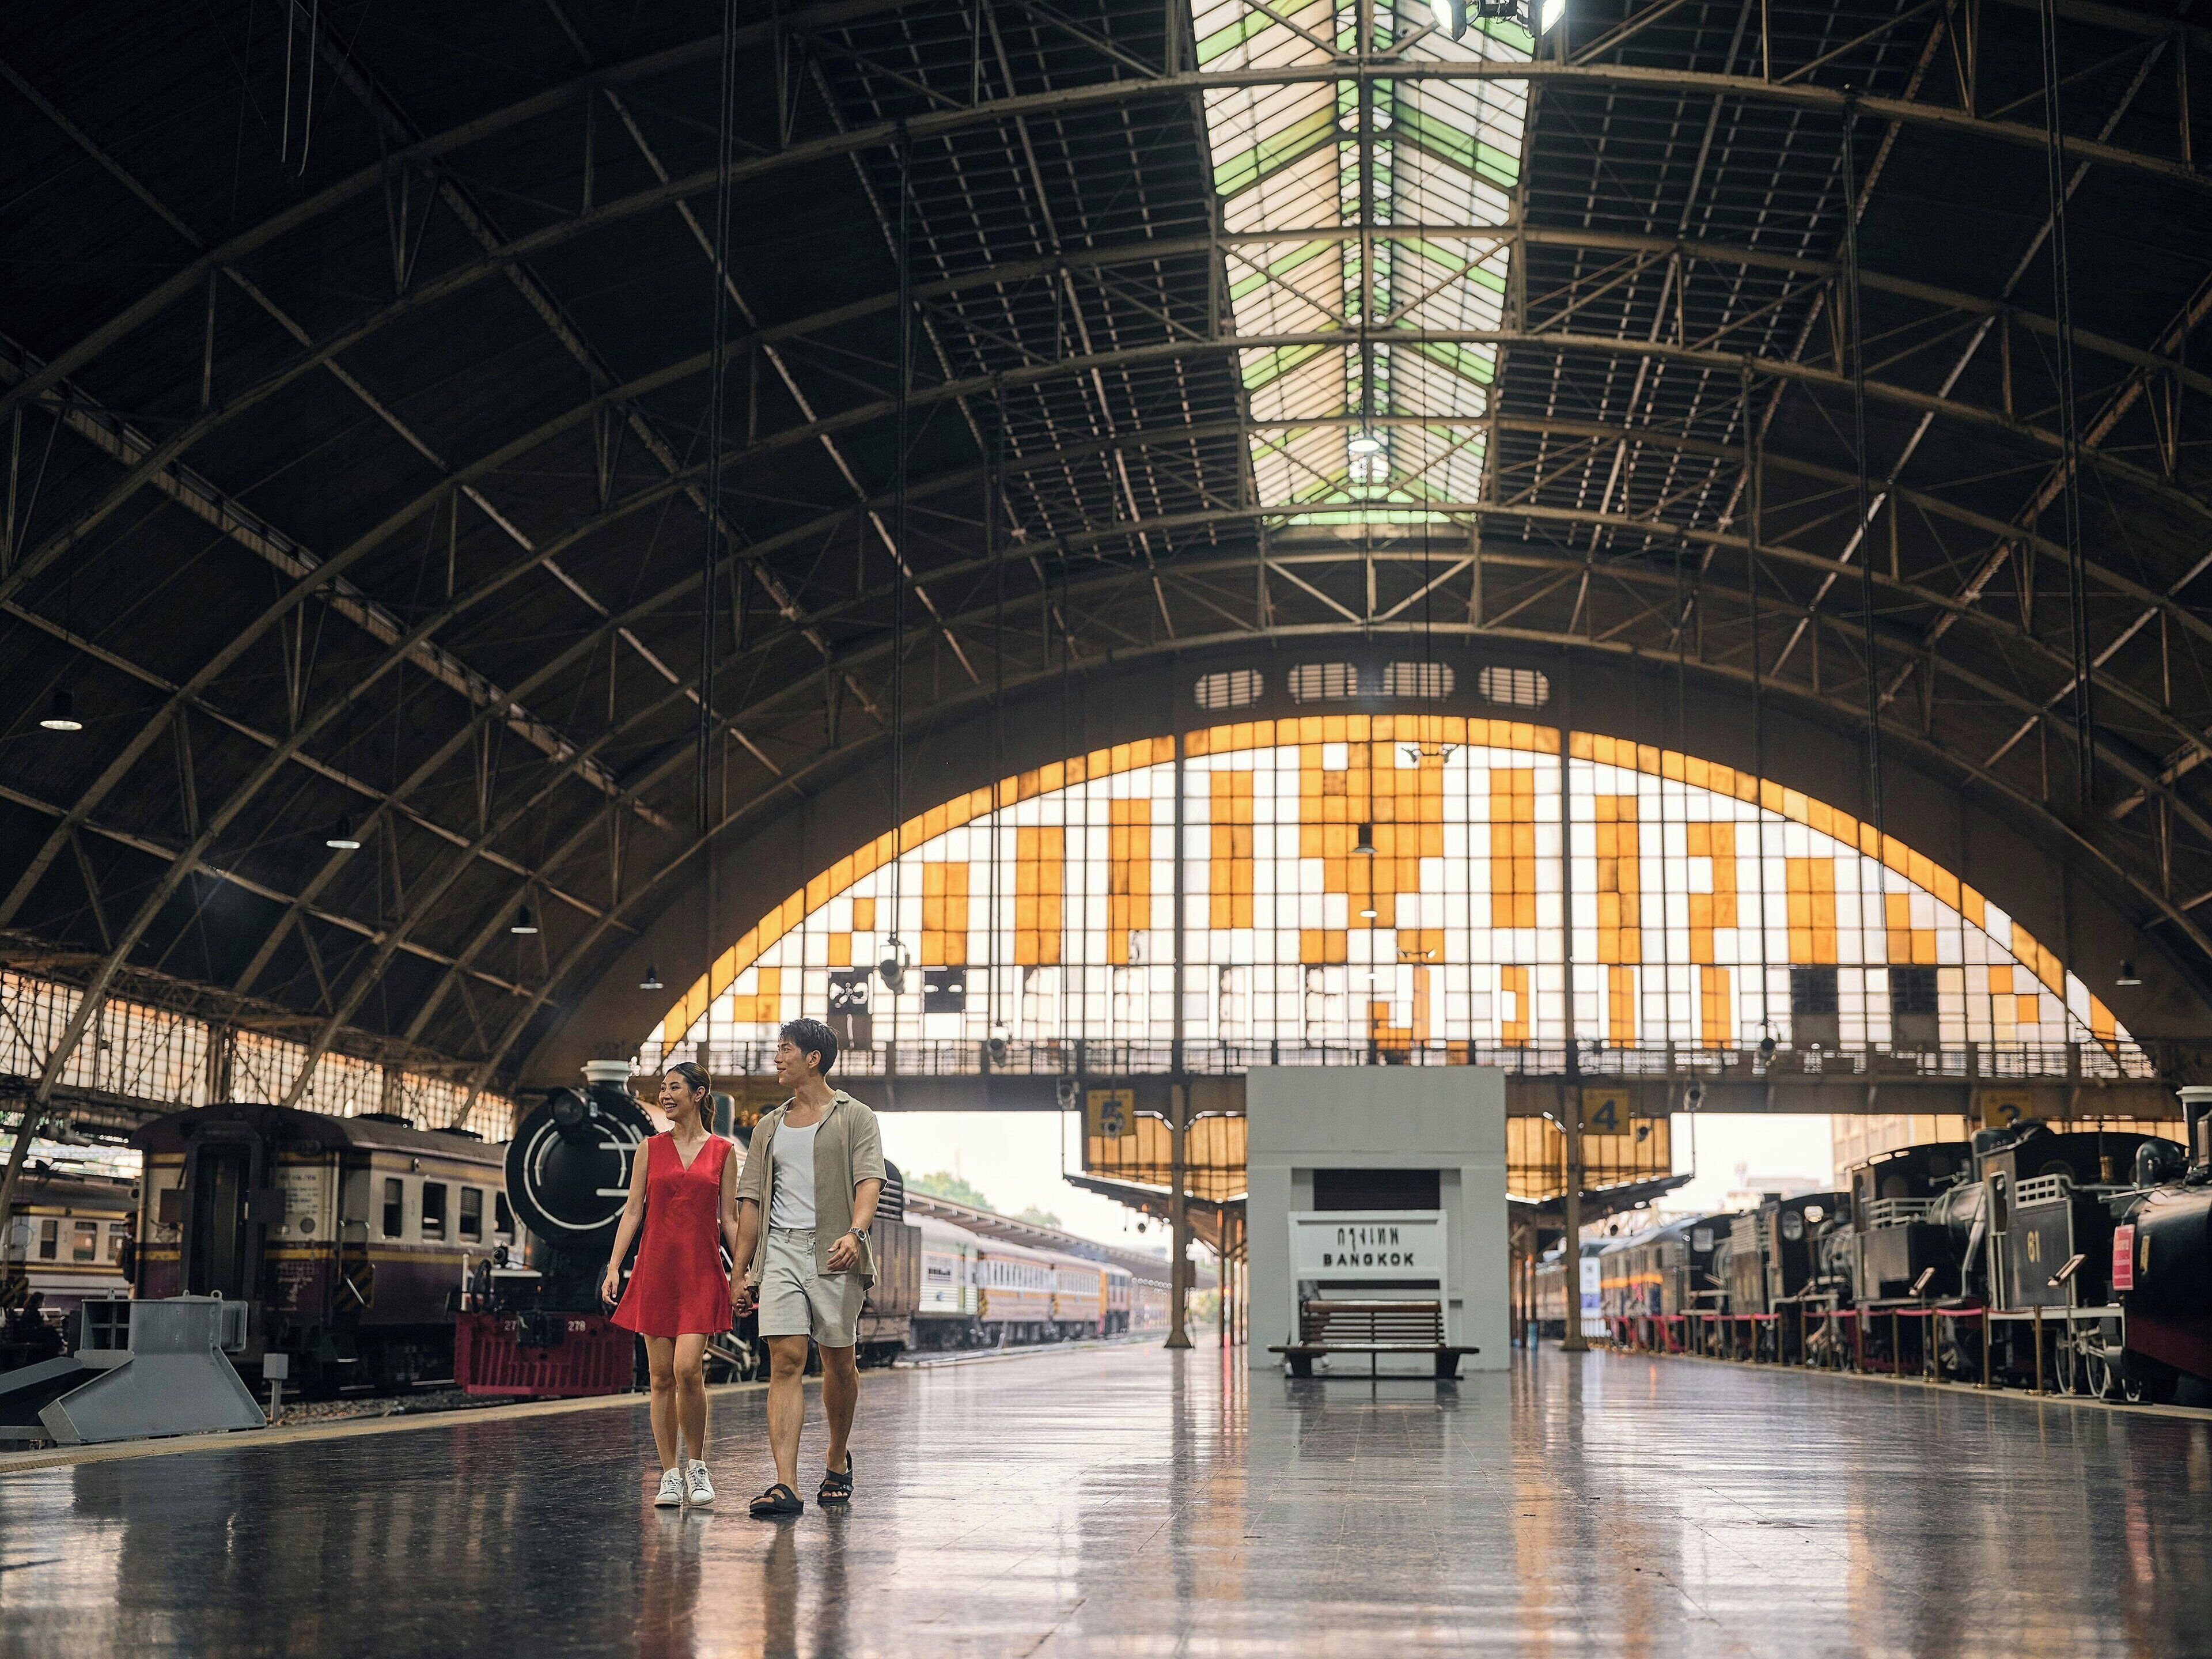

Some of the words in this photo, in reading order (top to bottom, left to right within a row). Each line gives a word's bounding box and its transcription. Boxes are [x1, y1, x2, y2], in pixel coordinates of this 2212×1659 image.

[1101, 1101, 1124, 1131] 5
[1592, 1100, 1620, 1131] 4
[2027, 1230, 2040, 1263] 61
[1323, 1252, 1414, 1267] BANGKOK
[504, 1320, 517, 1332] 27
[567, 1320, 586, 1332] 278
